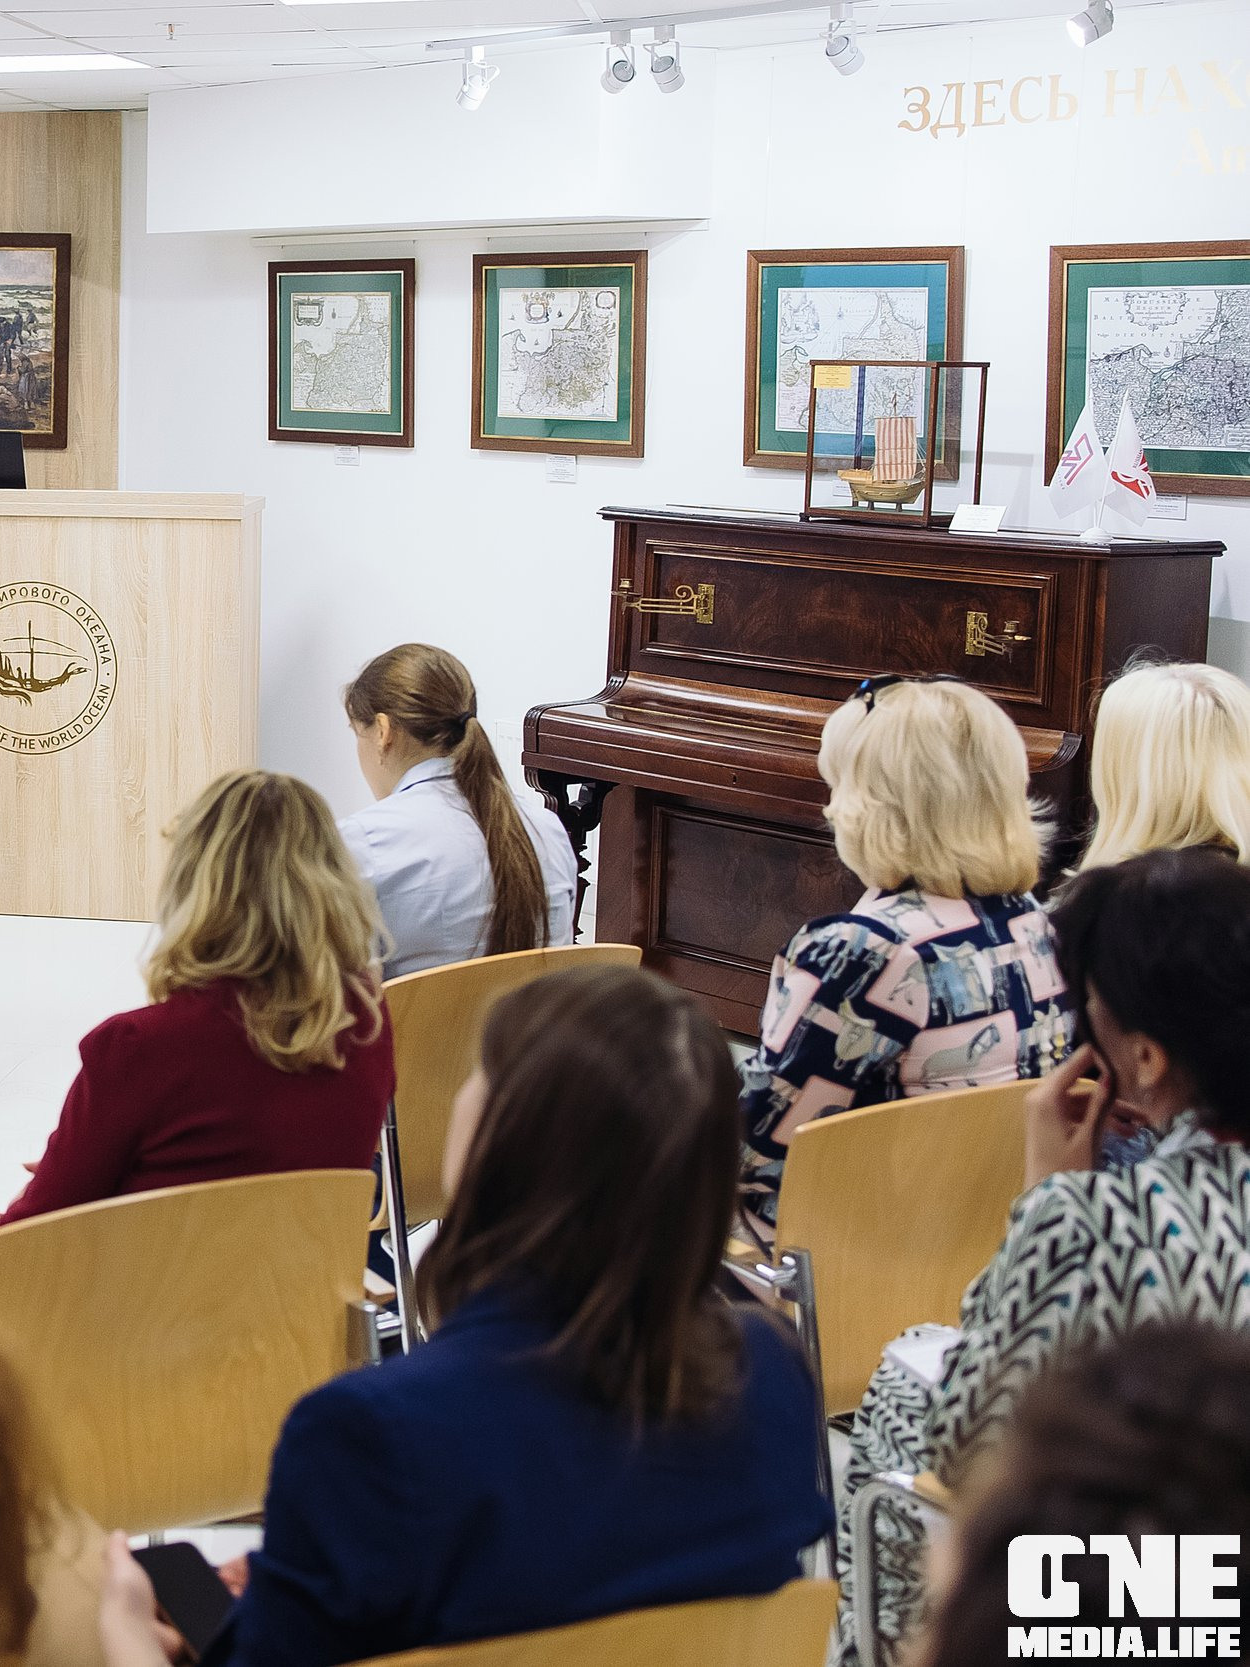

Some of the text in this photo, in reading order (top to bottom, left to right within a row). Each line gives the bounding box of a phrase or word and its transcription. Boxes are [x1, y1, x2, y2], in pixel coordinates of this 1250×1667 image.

[897, 58, 1250, 140] ЗДЕСЬ НАХ
[75, 606, 112, 665] ОКЕАНА
[11, 735, 36, 750] THE
[38, 723, 84, 749] WORLD
[82, 684, 111, 725] OCEAN
